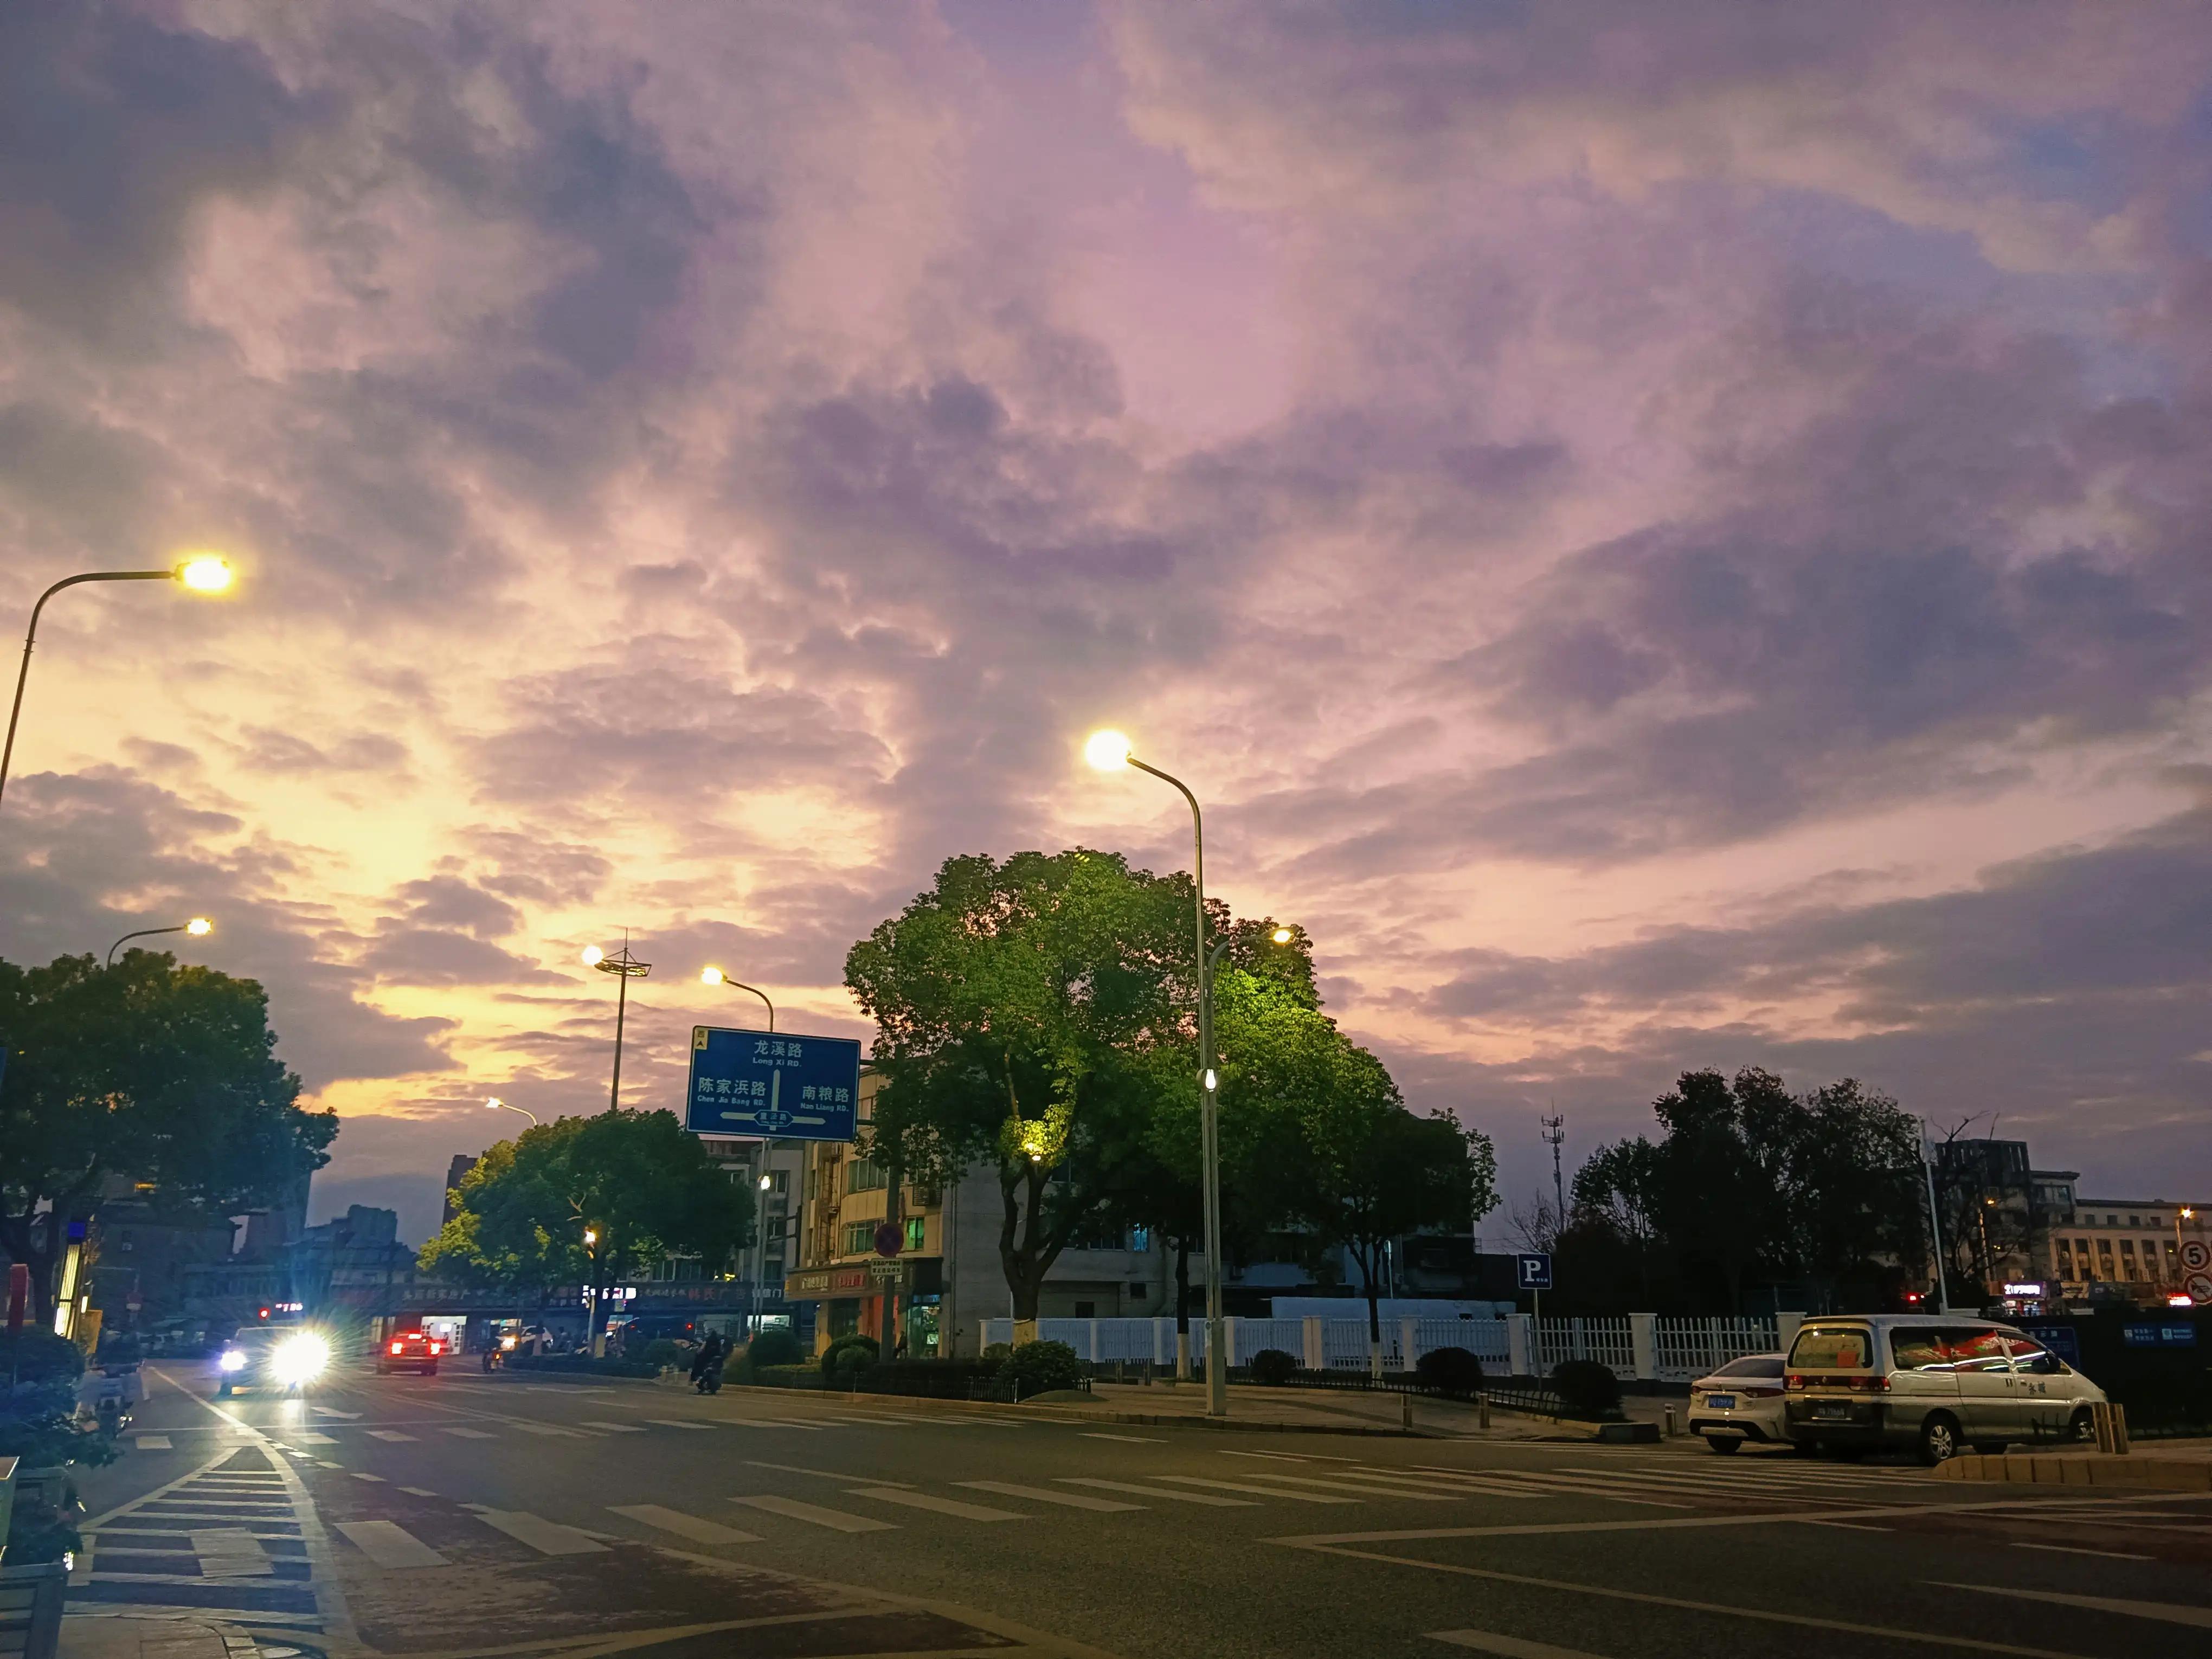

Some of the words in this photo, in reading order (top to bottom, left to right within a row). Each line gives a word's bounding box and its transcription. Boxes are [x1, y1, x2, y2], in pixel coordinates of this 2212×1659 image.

[754, 1039, 802, 1058] 龙溪路
[753, 1057, 773, 1066] Long
[698, 1077, 766, 1096] 陈家浜路
[802, 1085, 850, 1103] 南粮路
[2189, 1247, 2202, 1264] 5
[1523, 1260, 1541, 1282] P
